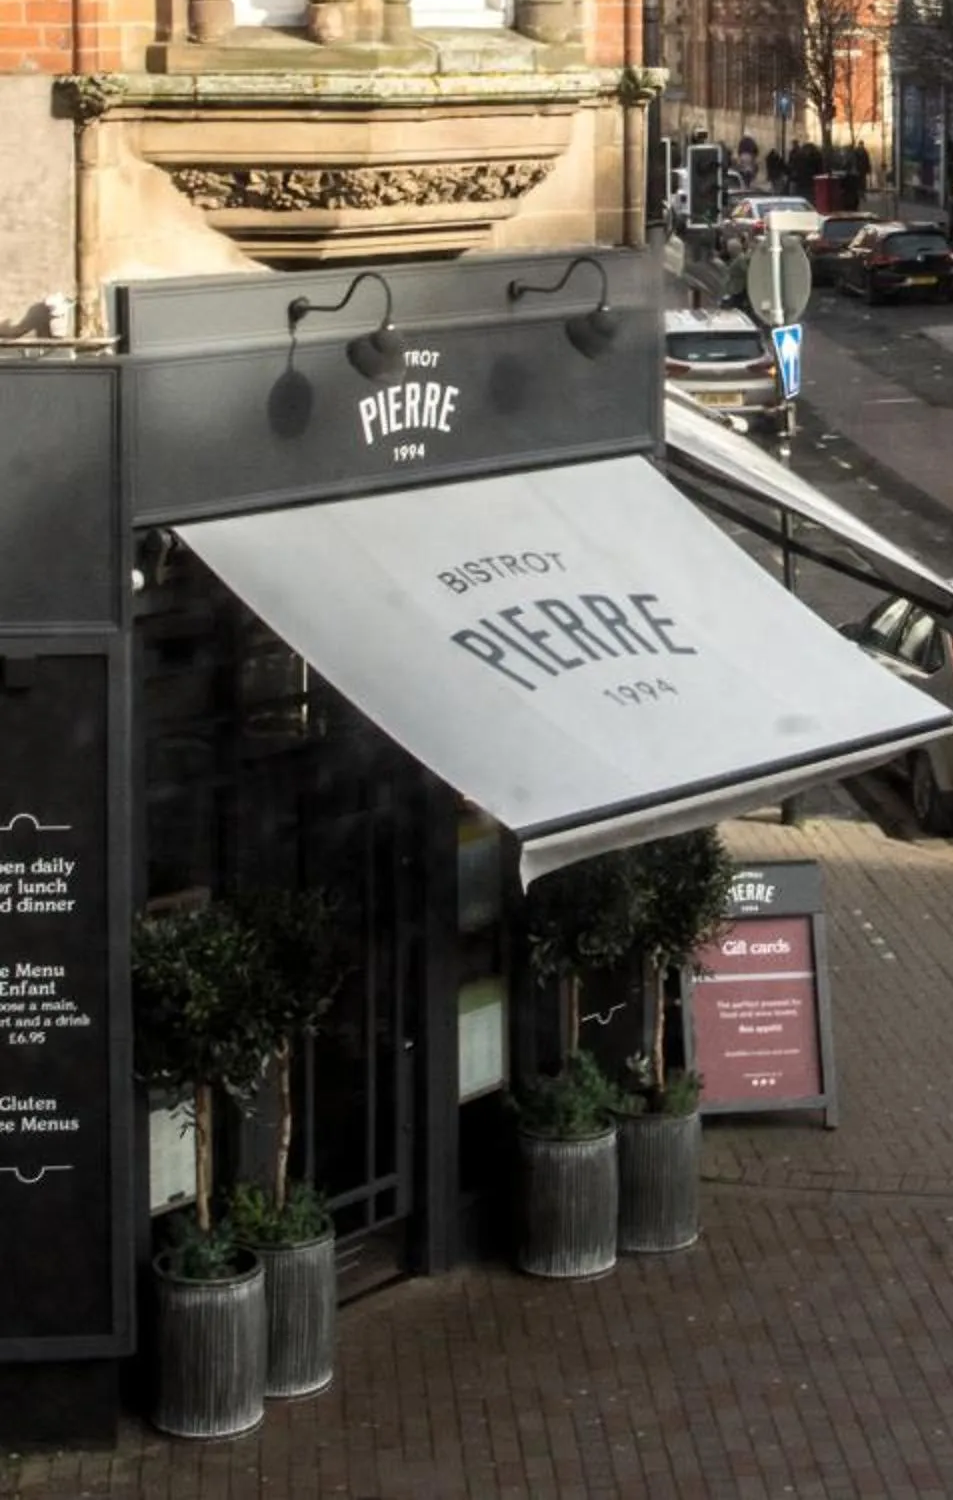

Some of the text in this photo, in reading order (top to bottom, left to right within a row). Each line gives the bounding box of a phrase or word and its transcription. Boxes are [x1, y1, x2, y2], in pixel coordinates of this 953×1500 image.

[404, 349, 440, 368] TROT
[359, 382, 459, 445] PIERRE
[394, 443, 425, 461] 1994
[437, 551, 567, 594] BISTROT
[450, 594, 698, 692] PIERRE
[602, 677, 679, 706] 1994
[31, 857, 75, 877] daily
[18, 878, 67, 894] lunch
[17, 897, 76, 913] dinner
[722, 938, 791, 955] Gift cards
[15, 963, 65, 978] Menu
[0, 980, 56, 996] Enfant
[15, 1015, 41, 1028] and
[9, 1031, 46, 1044] £6.95
[0, 1095, 57, 1111] Gluten
[21, 1116, 80, 1132] Menus
